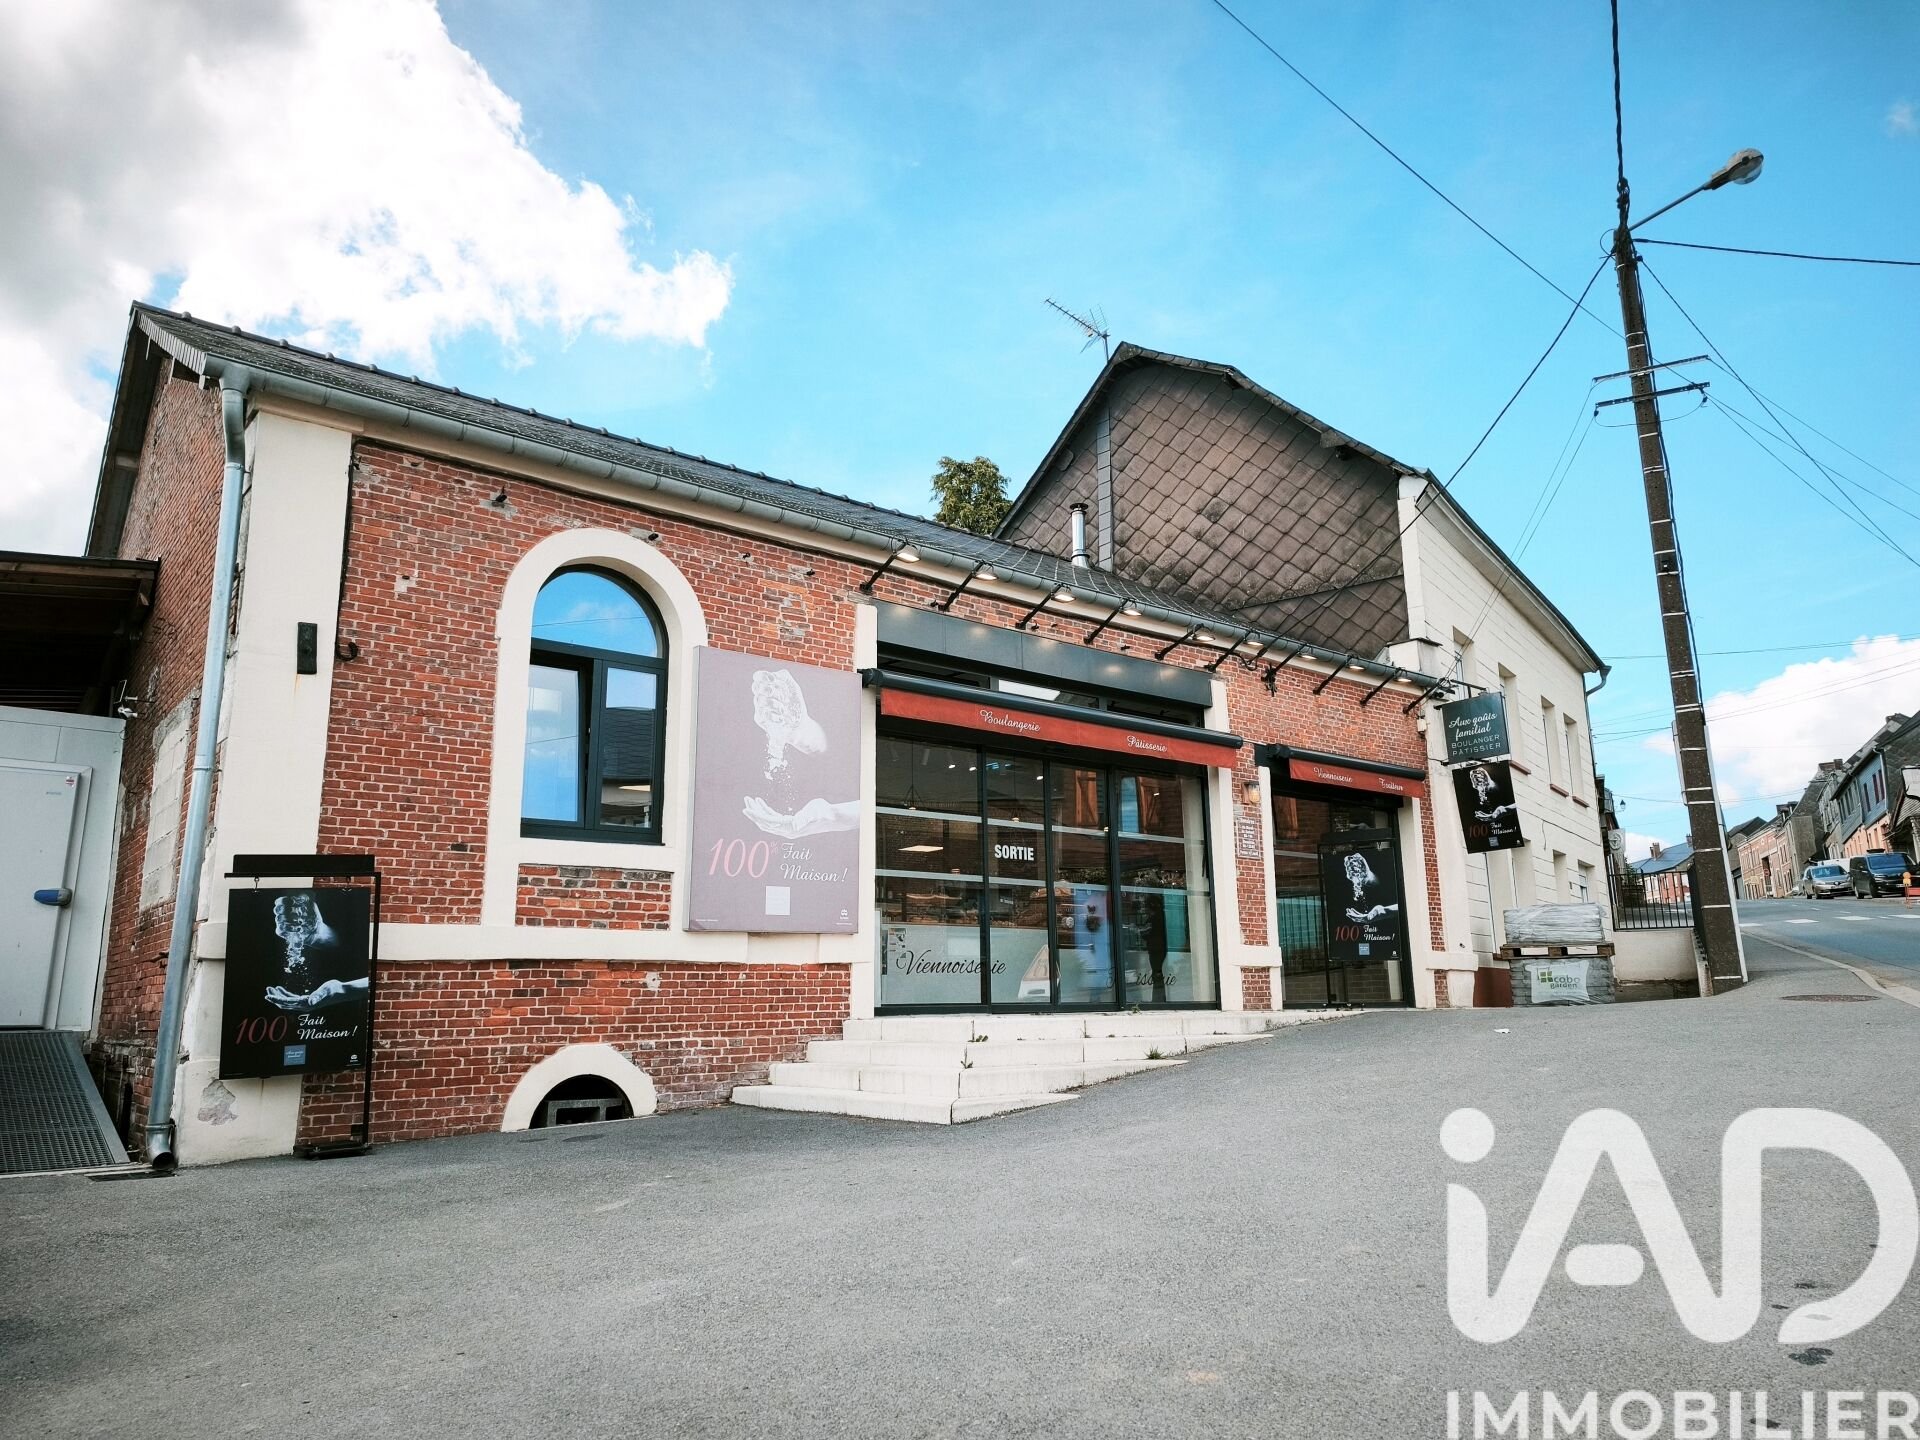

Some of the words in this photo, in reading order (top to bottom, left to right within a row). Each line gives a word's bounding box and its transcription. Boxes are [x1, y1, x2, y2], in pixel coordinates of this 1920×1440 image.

[1448, 716, 1471, 728] Aux
[980, 709, 1041, 734] Boulangerie
[1127, 735, 1168, 753] Pâtisserie
[1455, 722, 1492, 741] familial
[1452, 735, 1499, 748] BOULANGER
[780, 842, 813, 860] Fait
[994, 844, 1035, 861] SORTIE
[896, 949, 1007, 976] Viennoiseie
[297, 1013, 326, 1027] Fait
